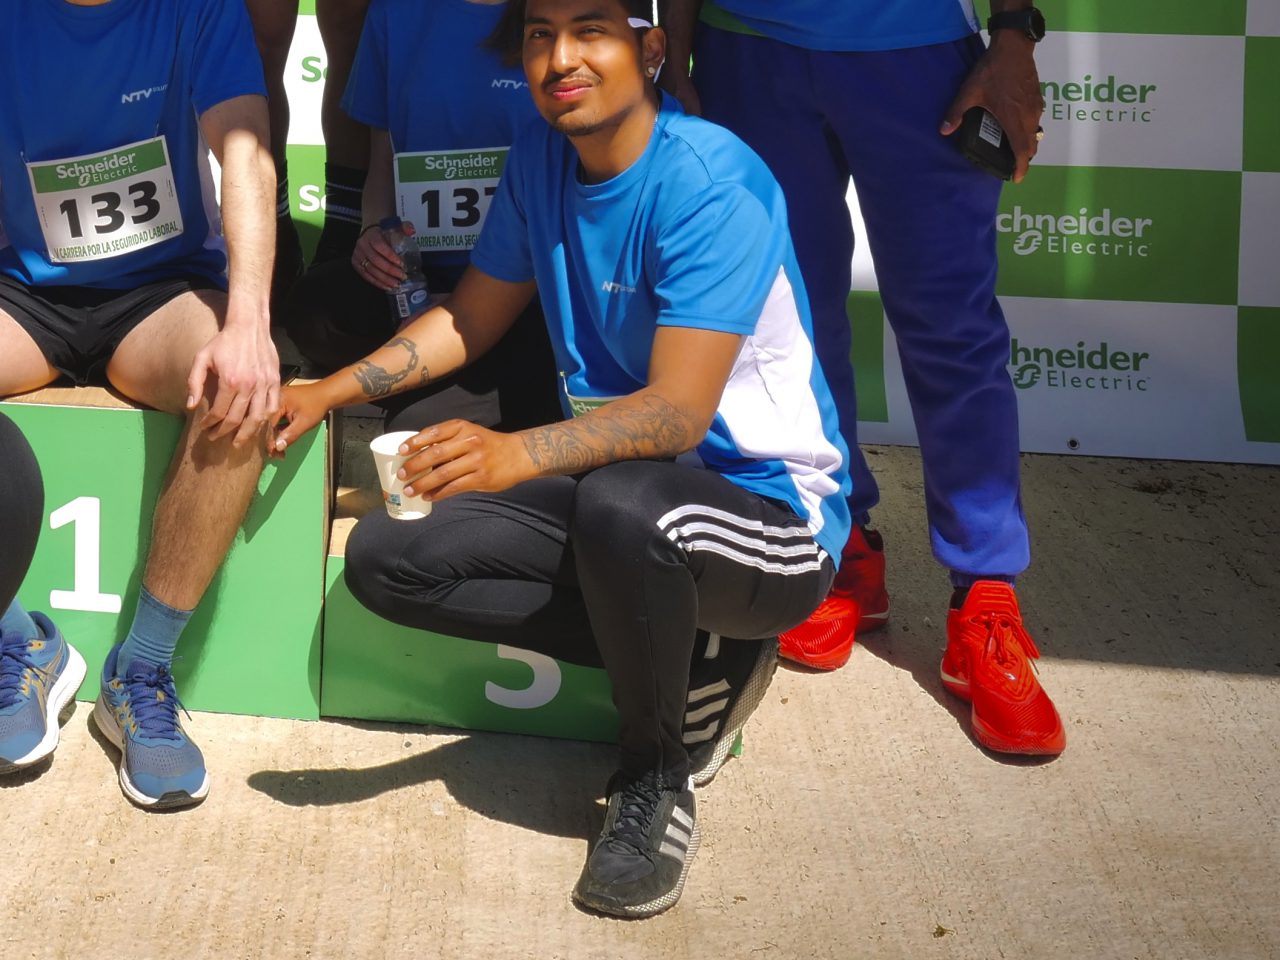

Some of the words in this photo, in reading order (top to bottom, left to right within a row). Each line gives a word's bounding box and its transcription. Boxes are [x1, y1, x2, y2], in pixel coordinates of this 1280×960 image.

[491, 79, 522, 89] NTV
[1041, 74, 1157, 103] neider
[121, 87, 152, 104] NTV
[1052, 104, 1152, 122] Electric
[56, 152, 136, 180] Schneider
[424, 154, 498, 170] Schneider
[458, 167, 498, 177] Electric
[93, 165, 138, 184] Electric
[59, 180, 161, 239] 133
[996, 206, 1153, 237] chneider
[59, 245, 87, 258] CARRERA
[87, 243, 101, 256] POR
[102, 242, 112, 253] LA
[112, 231, 149, 252] SEGURIDAD
[149, 221, 179, 240] LABORAL
[415, 234, 441, 248] ARRERA
[442, 235, 455, 247] POR
[456, 235, 465, 246] LA
[1047, 235, 1149, 256] Electric
[1011, 338, 1150, 371] hneider
[1047, 370, 1148, 390] Electric
[49, 496, 122, 614] 1
